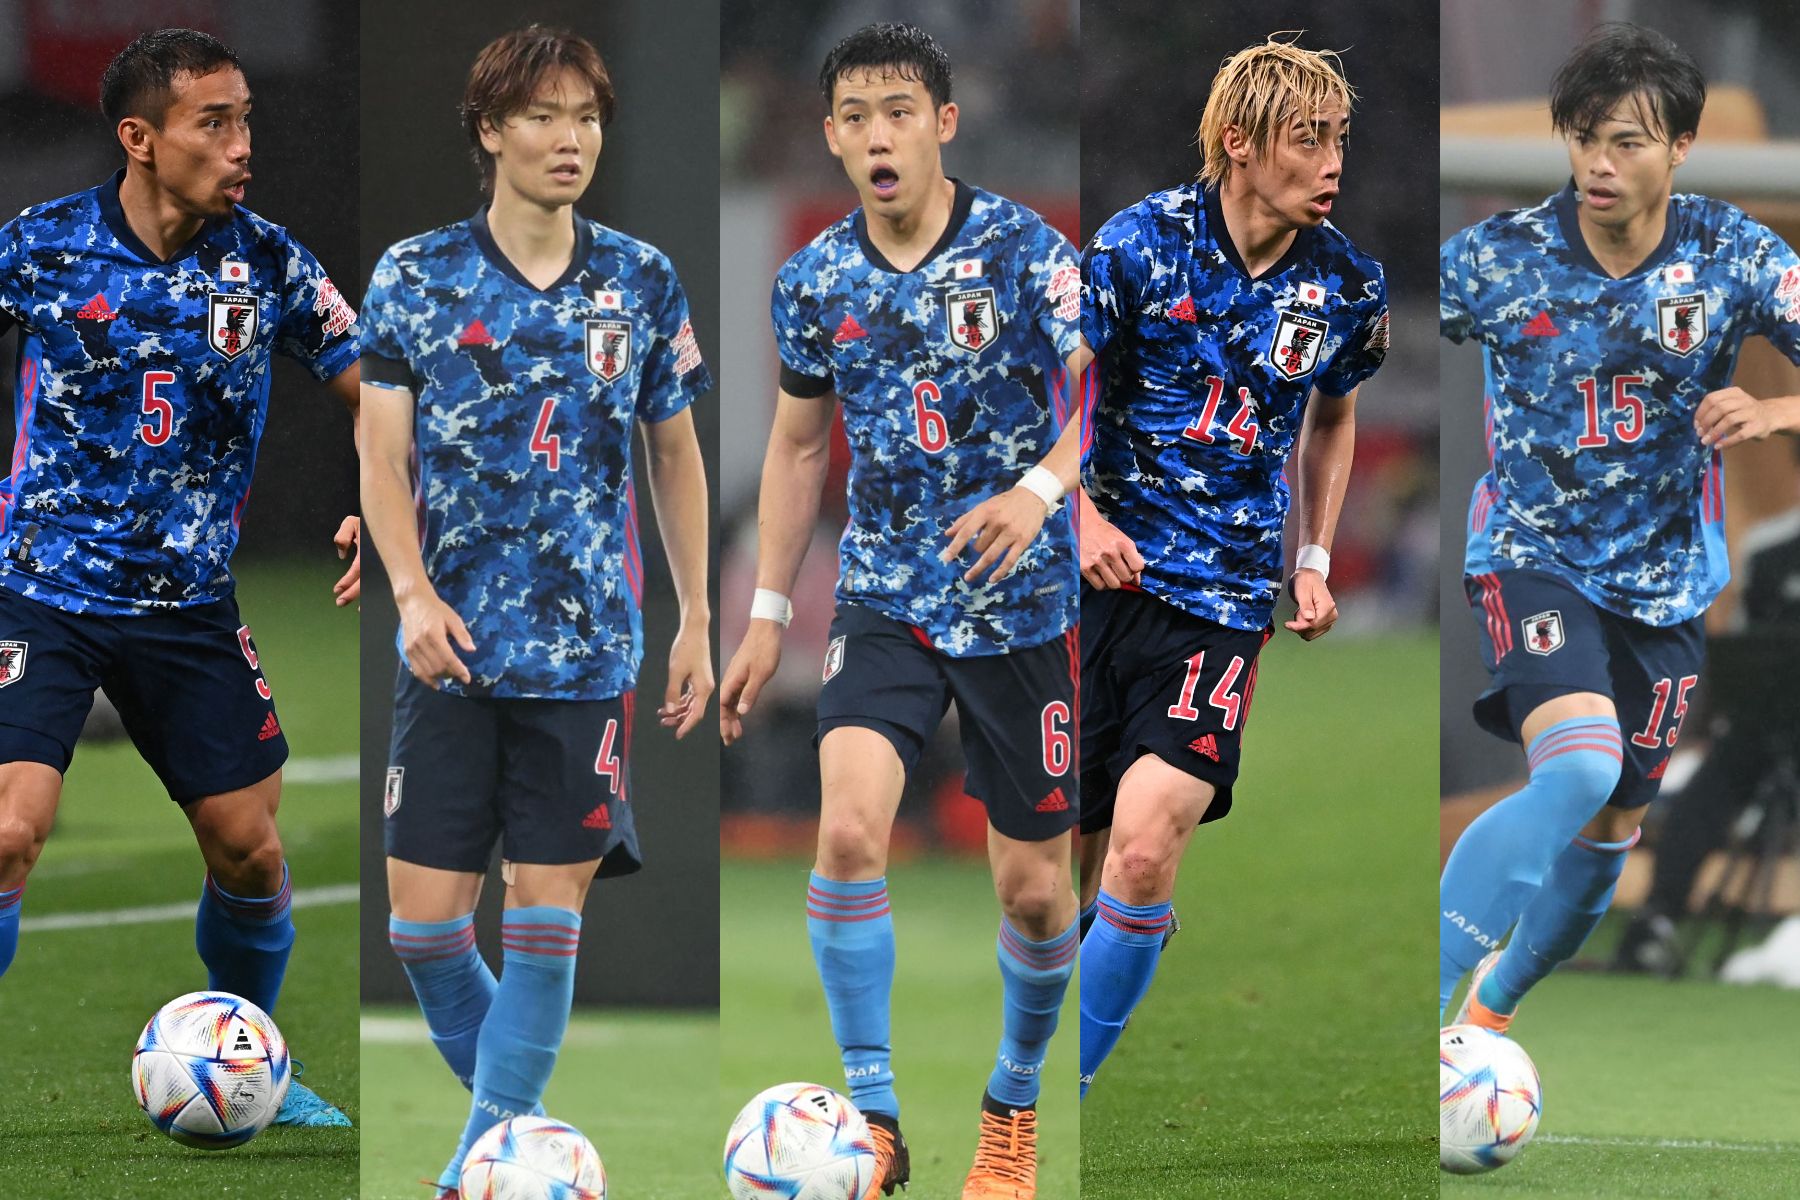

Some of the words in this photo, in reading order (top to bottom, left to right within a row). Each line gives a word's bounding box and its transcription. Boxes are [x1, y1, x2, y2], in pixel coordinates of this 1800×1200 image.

[223, 296, 249, 304] JAPAN
[957, 292, 982, 300] JAPAN
[1062, 290, 1080, 305] KIRI
[1669, 297, 1695, 305] JAPAN
[77, 310, 117, 320] adidas
[1292, 316, 1318, 328] JAPAN
[333, 319, 349, 336] CUP
[222, 339, 242, 349] JFA
[1281, 357, 1303, 371] JFA
[141, 370, 174, 446] 5
[912, 380, 948, 454] 6
[1182, 375, 1258, 456] 14
[1577, 375, 1645, 448] 15
[530, 397, 560, 471] 4
[0, 671, 12, 679] FA
[1168, 650, 1244, 731] 14
[1631, 674, 1698, 748] 15
[1041, 700, 1071, 777] 6
[595, 719, 620, 784] 4
[1443, 910, 1500, 950] JAPAN
[477, 1099, 534, 1119] JAP
